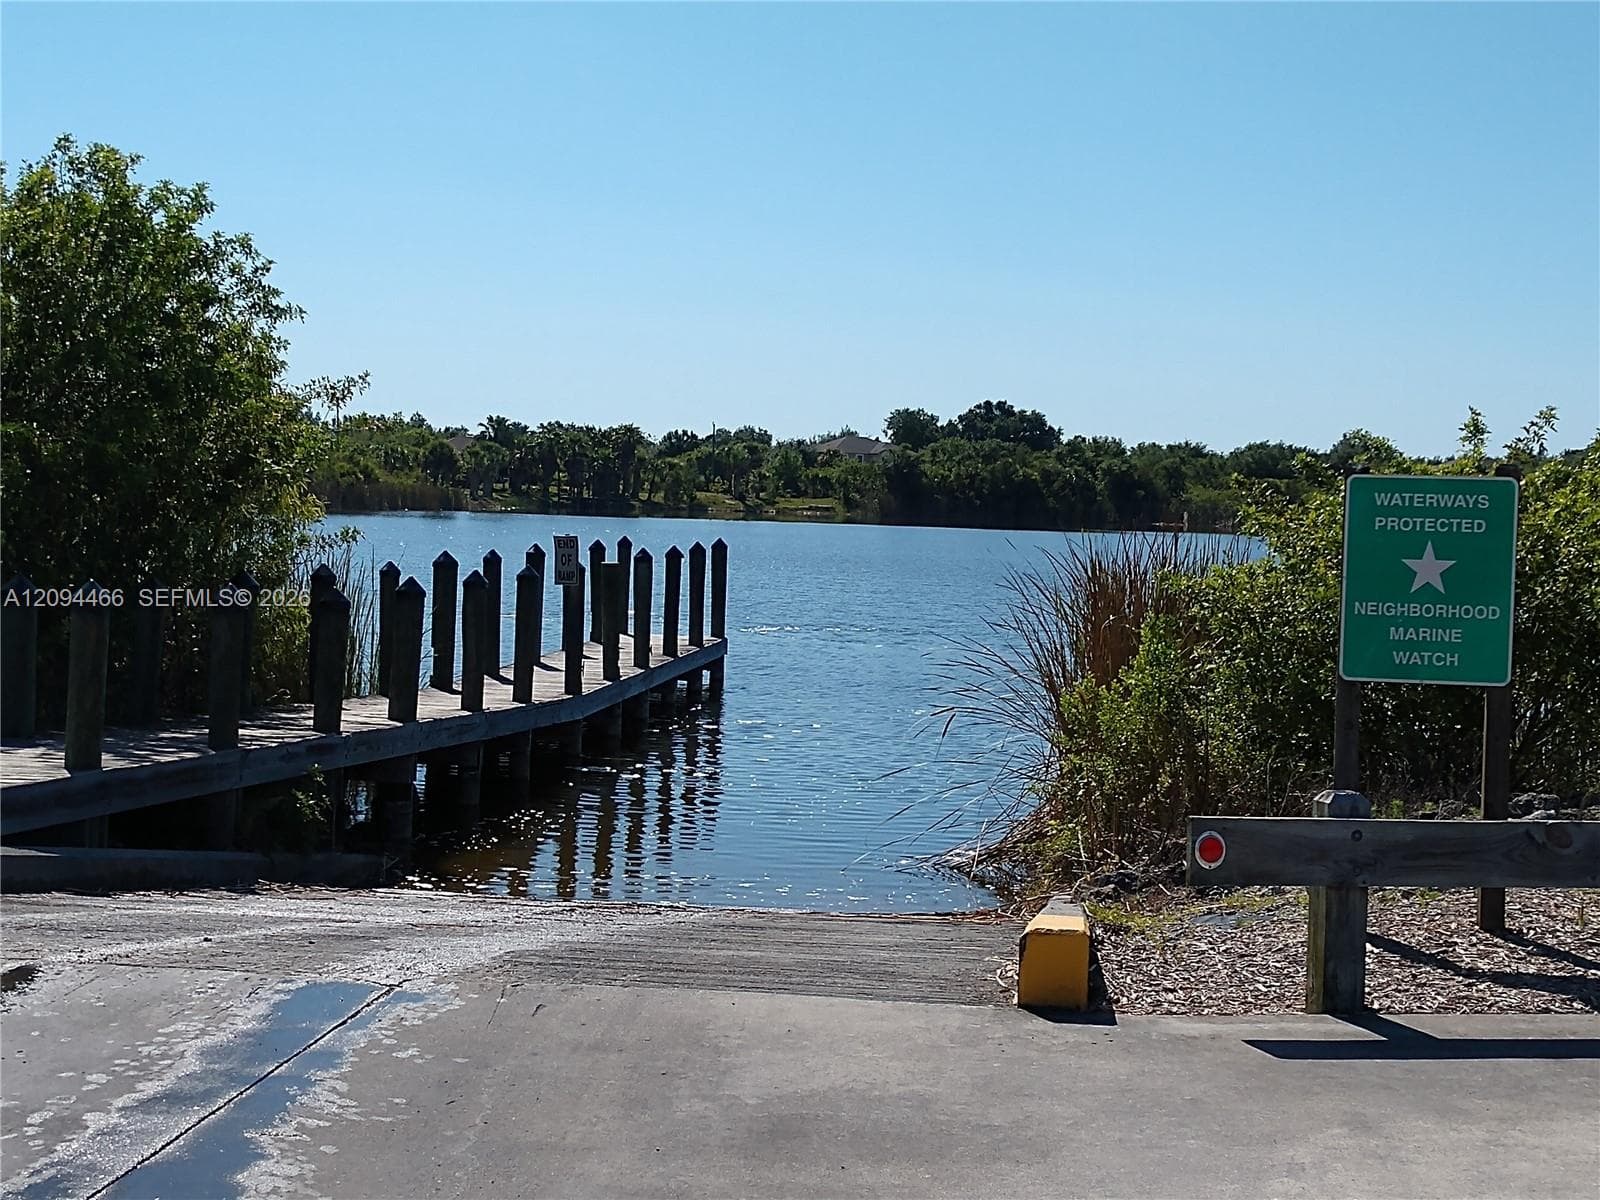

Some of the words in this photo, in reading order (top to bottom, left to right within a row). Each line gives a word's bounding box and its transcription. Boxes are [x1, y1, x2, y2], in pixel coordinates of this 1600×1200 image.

[1375, 492, 1490, 509] WATERWAYS
[1374, 517, 1486, 533] PROTECTED
[557, 538, 576, 549] END
[560, 553, 573, 566] OF
[1354, 601, 1501, 620] NEIGHBORHOOD
[1389, 626, 1463, 643] MARINE
[1392, 651, 1459, 667] WATCH
